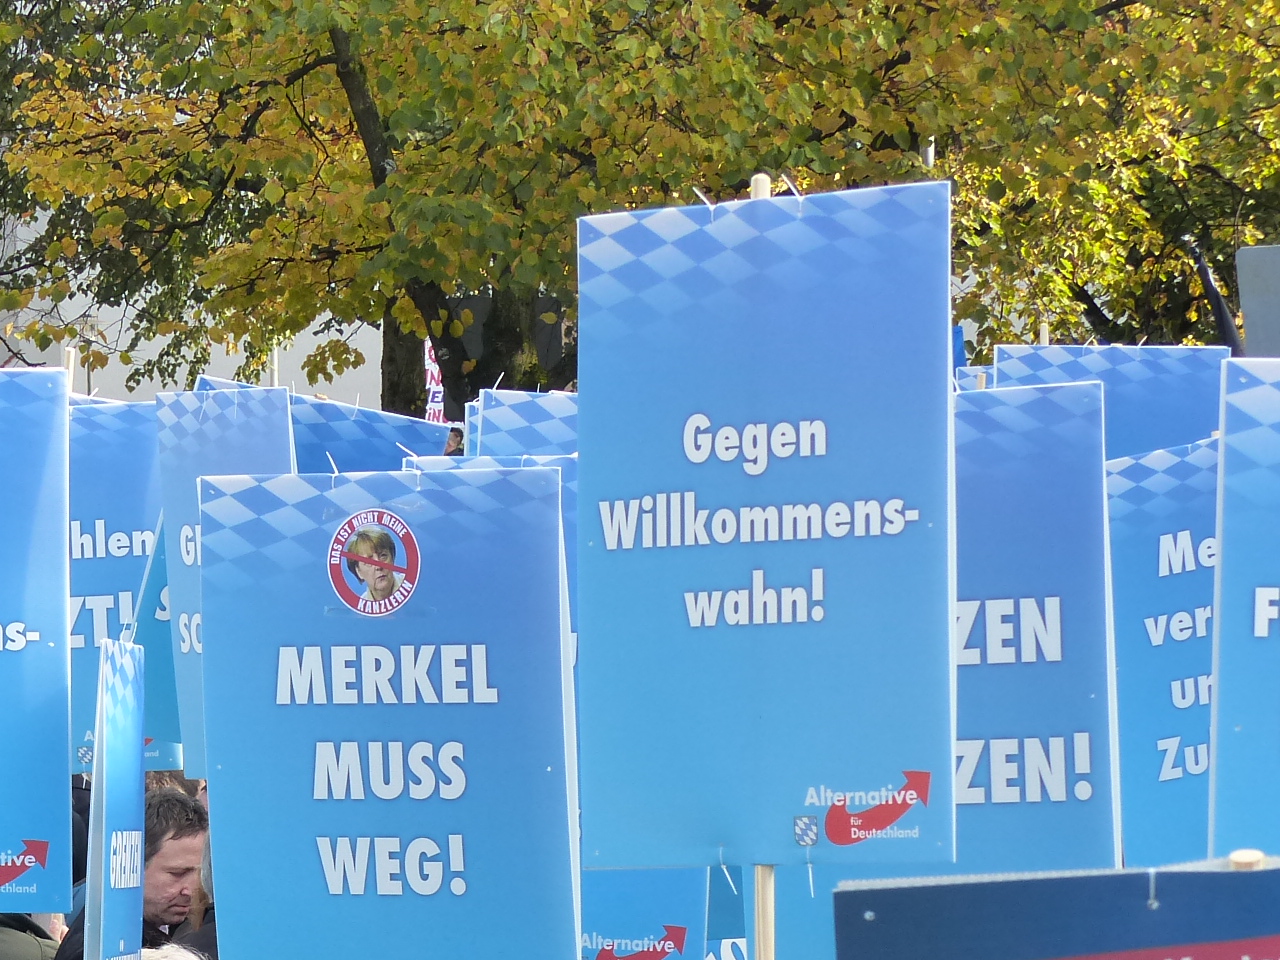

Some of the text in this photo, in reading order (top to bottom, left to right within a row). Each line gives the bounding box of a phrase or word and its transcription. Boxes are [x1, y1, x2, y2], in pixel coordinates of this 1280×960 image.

[682, 413, 826, 475] Gegen
[330, 512, 407, 564] DAS IST NICHT MEINE
[599, 491, 919, 550] Willkommens-
[357, 580, 413, 613] KANZLERIN
[684, 568, 824, 627] wahn!
[275, 644, 499, 705] MERKEL
[313, 741, 466, 800] MUSS
[1157, 729, 1212, 781] Zu
[804, 785, 918, 806] Alternative
[850, 817, 863, 826] für
[110, 830, 142, 889] GRENZEN
[851, 826, 919, 839] Deutschland
[316, 834, 467, 896] WEG!
[581, 932, 675, 953] Alternative
